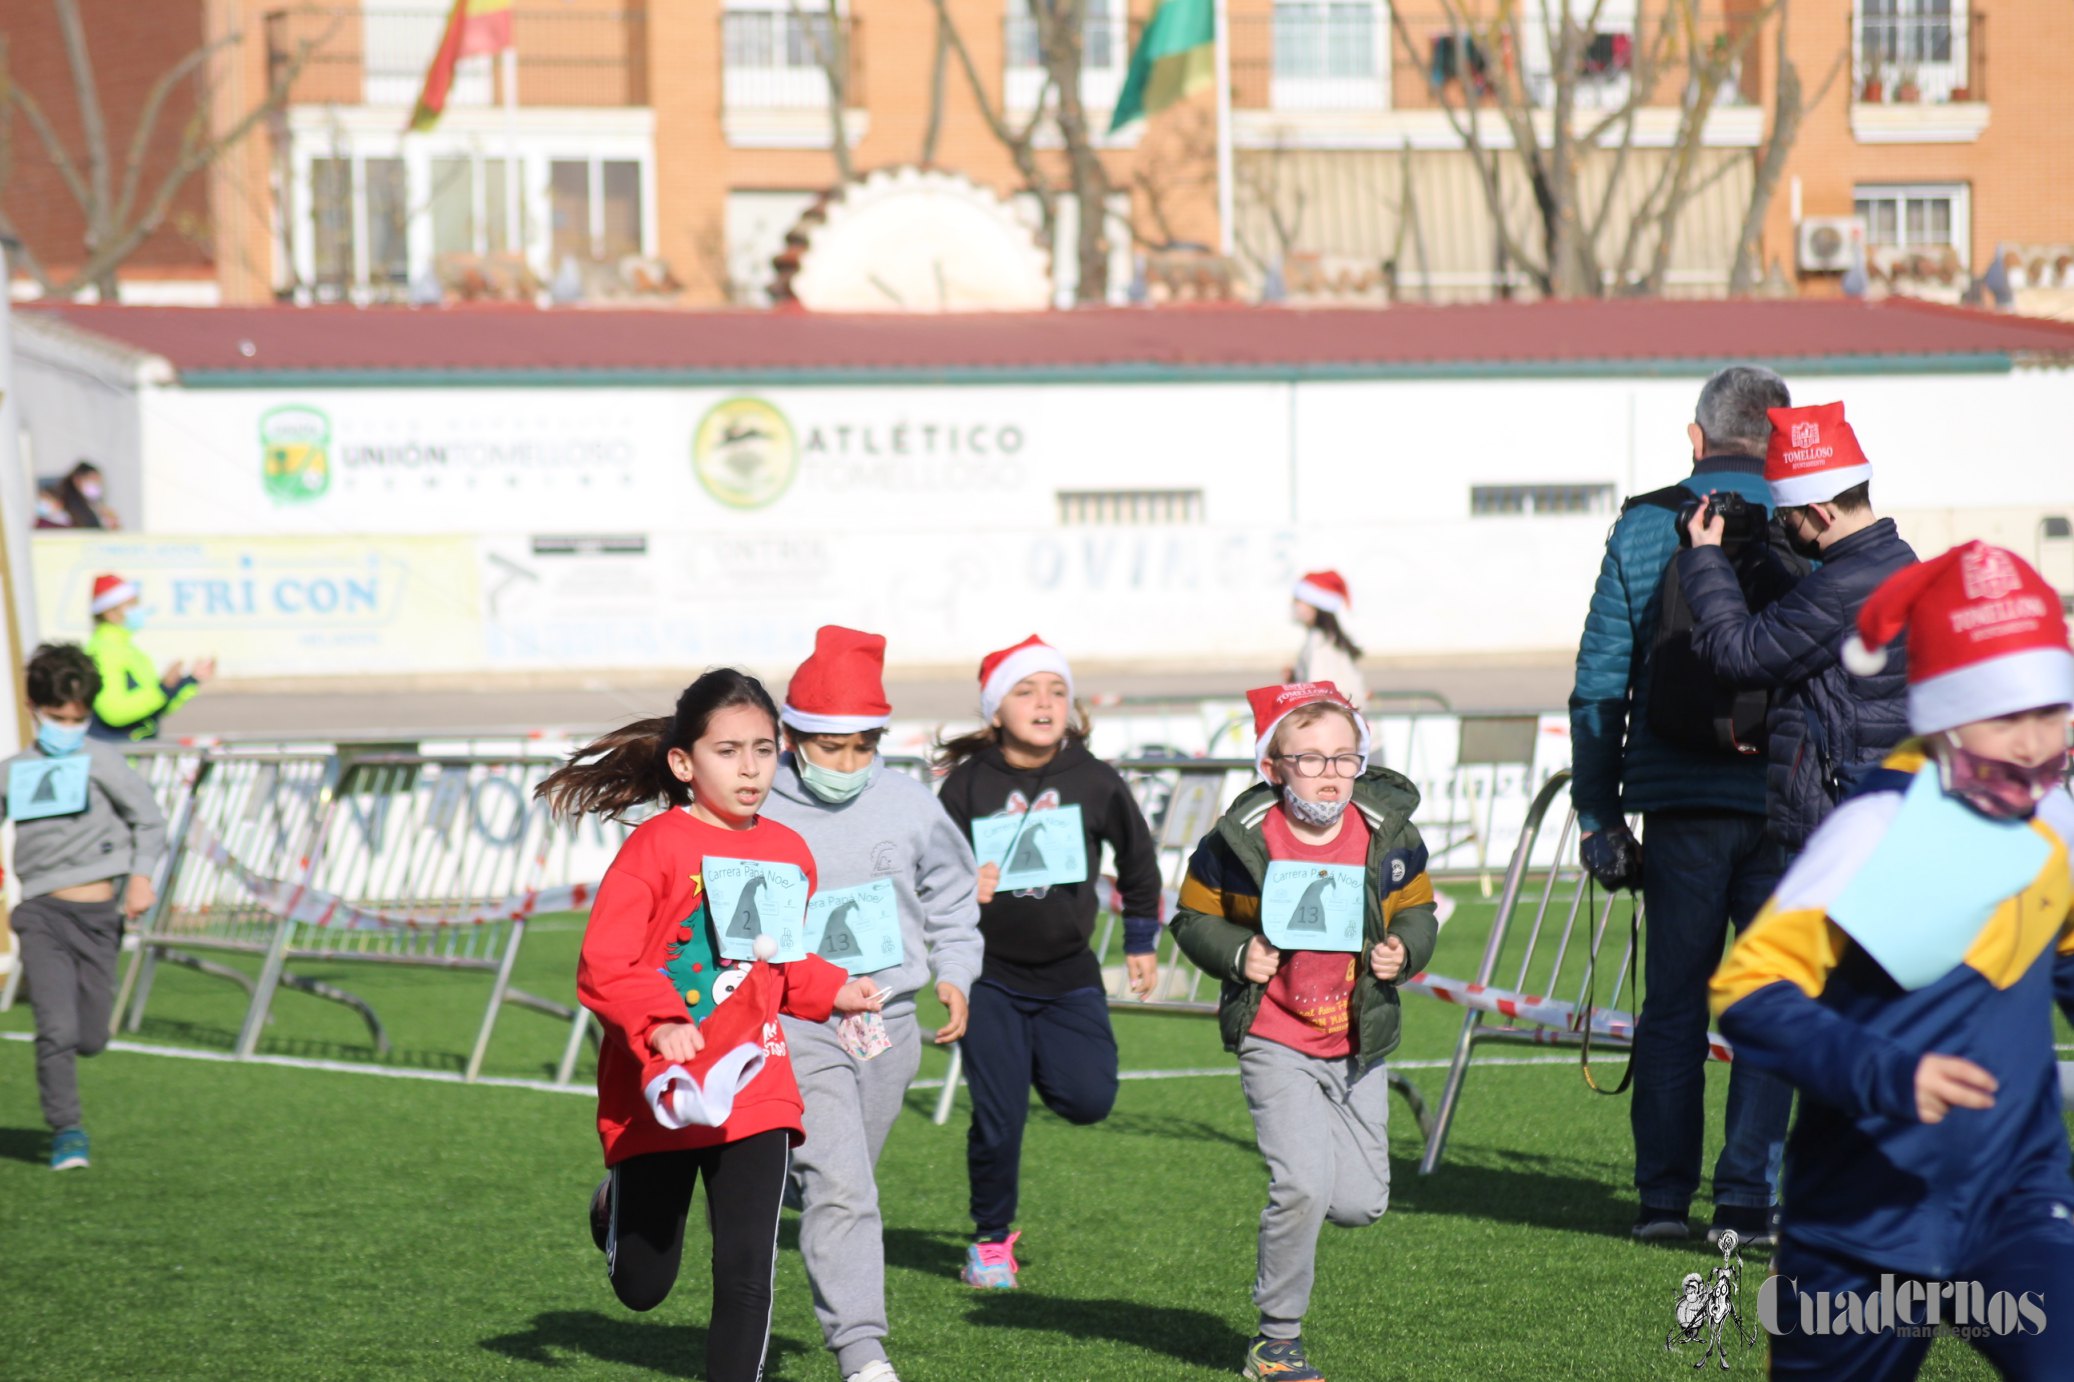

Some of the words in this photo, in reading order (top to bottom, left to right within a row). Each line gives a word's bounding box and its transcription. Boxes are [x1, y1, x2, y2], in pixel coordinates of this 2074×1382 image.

[803, 414, 1026, 457] ATLÉTICO
[1783, 447, 1833, 464] TOMELLOSO
[708, 867, 741, 882] Carrera
[744, 866, 765, 879] Papá
[768, 870, 795, 888] Noel
[1273, 869, 1308, 883] Carrera
[742, 910, 752, 930] 2
[1300, 906, 1319, 924] 13
[826, 933, 850, 953] 13
